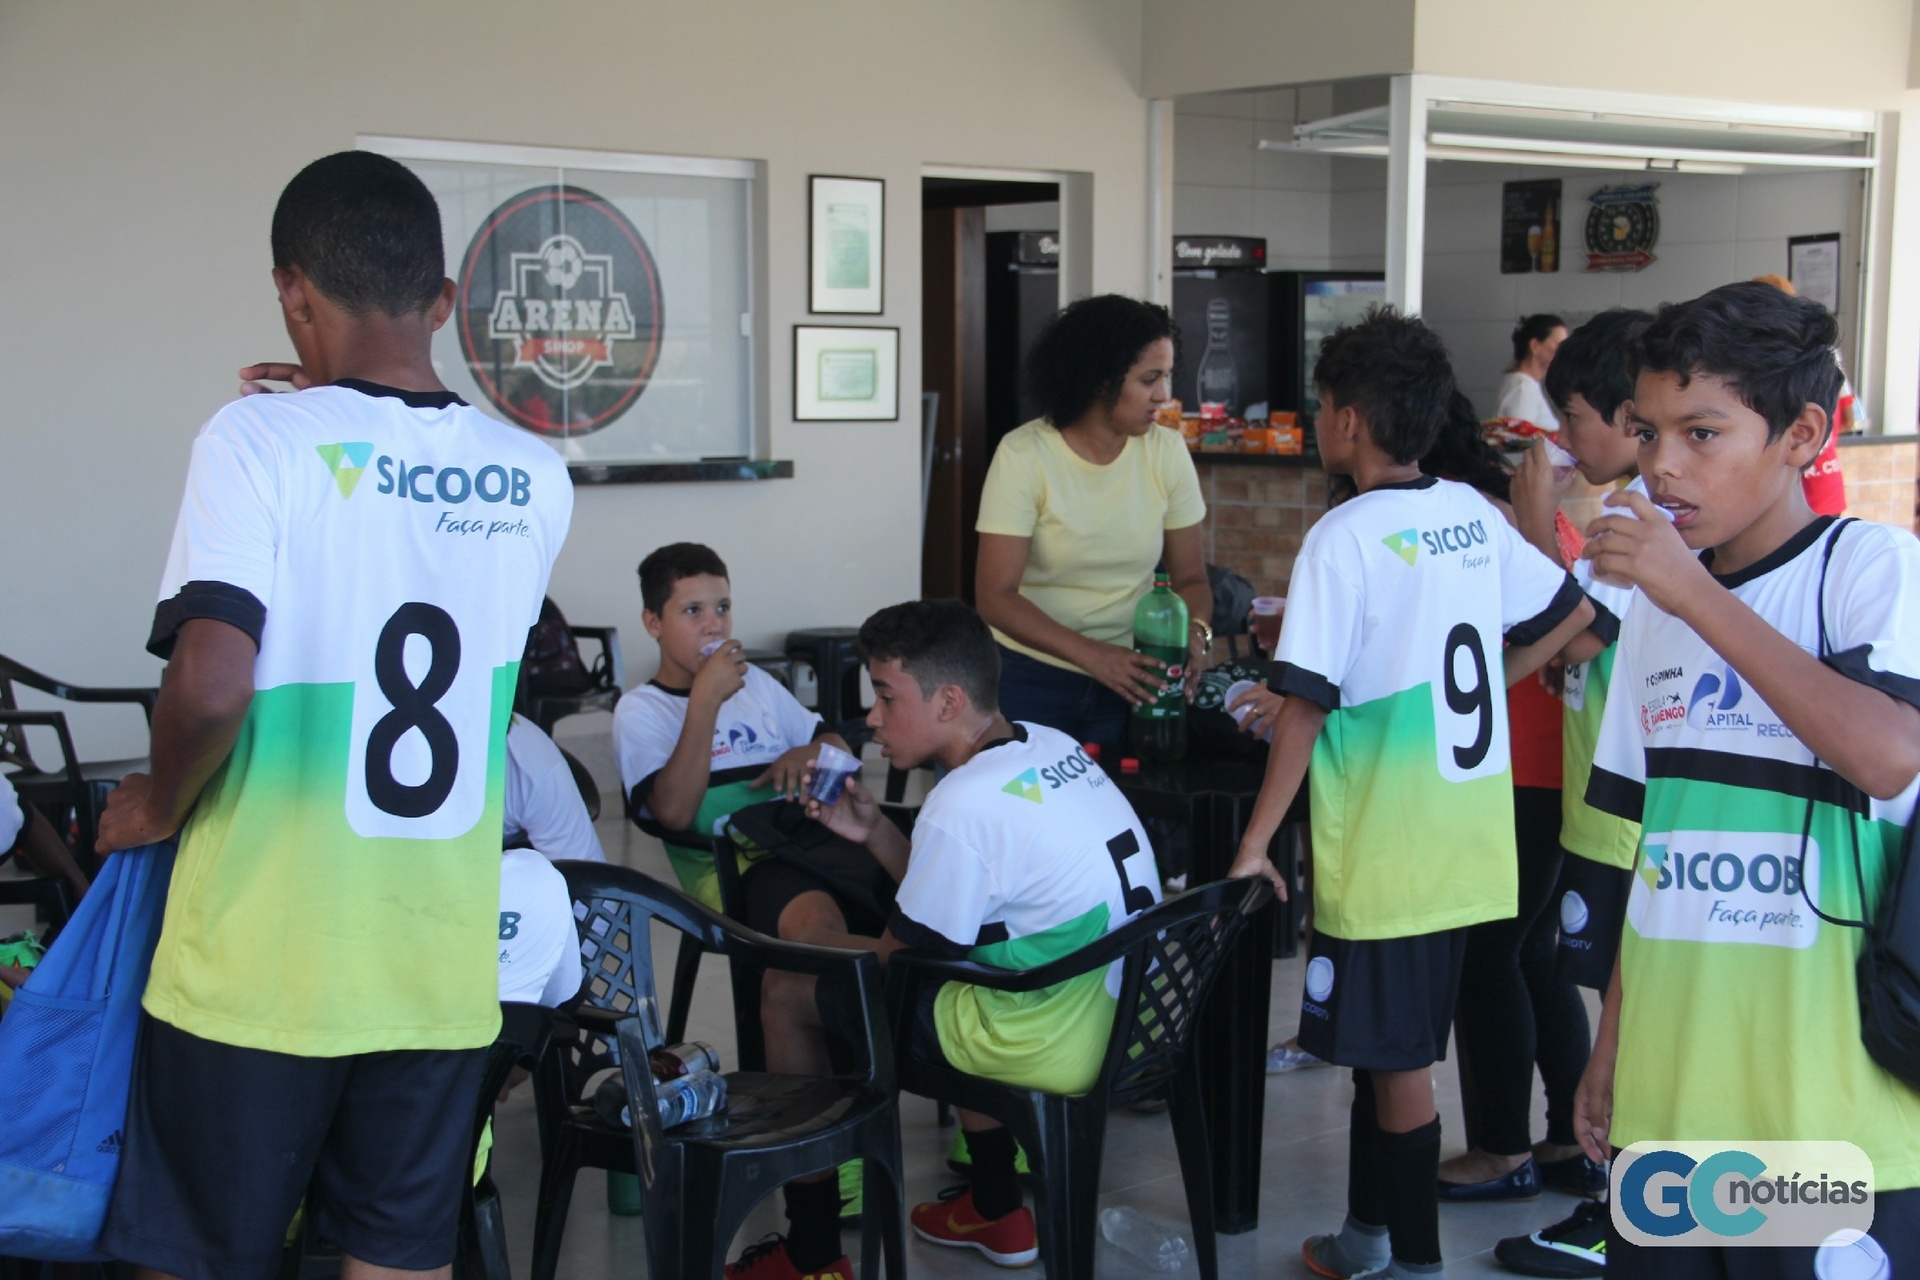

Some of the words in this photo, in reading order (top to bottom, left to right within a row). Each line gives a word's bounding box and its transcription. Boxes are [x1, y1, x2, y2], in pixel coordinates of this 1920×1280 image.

[496, 299, 629, 331] ARENA
[377, 454, 532, 507] SICOOB
[435, 511, 484, 539] Faça
[486, 518, 530, 540] parte.
[1422, 519, 1488, 555] SICOO
[364, 601, 461, 818] 8
[1443, 622, 1493, 770] 9
[1106, 828, 1156, 915] 5
[1656, 852, 1801, 896] SICOOB
[1708, 900, 1757, 925] Faça
[1759, 908, 1804, 931] parte.
